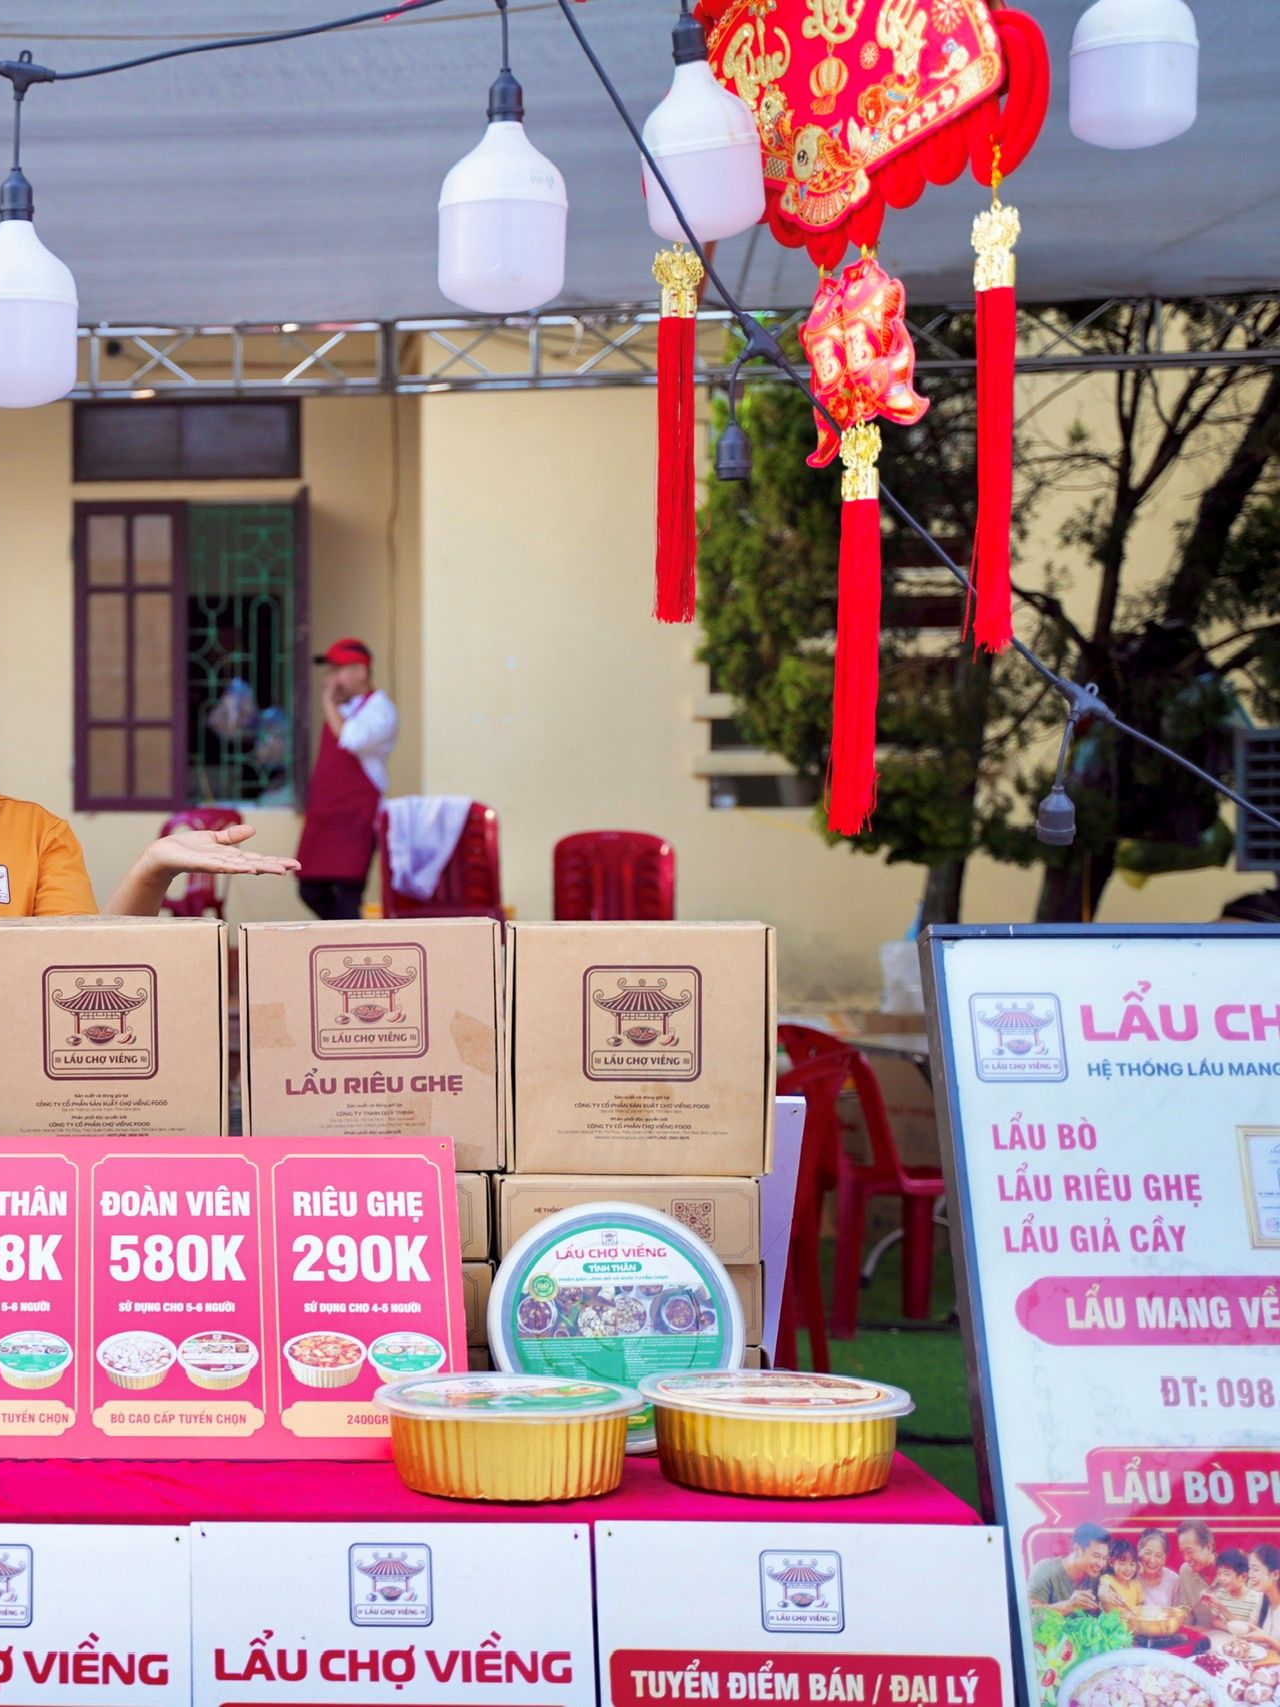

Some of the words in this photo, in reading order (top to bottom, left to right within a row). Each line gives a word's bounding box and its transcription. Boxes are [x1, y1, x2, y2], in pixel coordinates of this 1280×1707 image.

[1080, 980, 1198, 1041] LẨU
[285, 1068, 337, 1096] LẨU
[344, 1071, 403, 1095] RIÊU
[410, 1075, 463, 1096] GHẸ
[1087, 1059, 1112, 1081] HỆ
[1116, 1059, 1183, 1077] THỐNG
[1187, 1058, 1224, 1077] LẨU
[992, 1112, 1046, 1151] LẨU
[1057, 1117, 1097, 1151] BÒ
[100, 1185, 178, 1218] ĐOÀN
[185, 1185, 250, 1218] VIÊN
[997, 1162, 1052, 1202] LẨU
[1064, 1168, 1132, 1202] RIÊU
[1143, 1173, 1203, 1208] GHẸ
[293, 1186, 358, 1218] RIÊU
[367, 1191, 424, 1223] GHẸ
[1003, 1213, 1059, 1253] LẨU
[1070, 1217, 1121, 1253] GIẢ
[1130, 1215, 1186, 1253] CẦY
[109, 1234, 246, 1282] 580K
[292, 1235, 431, 1282] 290K
[589, 1247, 618, 1260] CHỢ
[1, 1301, 18, 1312] 5-6
[163, 1302, 184, 1313] CHO
[186, 1302, 203, 1313] 5-6
[349, 1303, 369, 1314] CHO
[372, 1303, 389, 1314] 4-5
[1065, 1283, 1126, 1330] LẨU
[1136, 1296, 1232, 1330] MANG
[1239, 1285, 1280, 1330] VỀ
[1160, 1376, 1208, 1407] ĐT:
[39, 1412, 69, 1425] CHỌN
[129, 1413, 151, 1424] CAO
[216, 1413, 247, 1426] CHỌN
[347, 1414, 390, 1426] 2400GR
[1102, 1456, 1171, 1504] LẨU
[1183, 1462, 1235, 1504] BÒ
[23, 1632, 169, 1685] VIỀNG
[214, 1630, 308, 1681] LẨU
[319, 1645, 416, 1689] CHỢ
[425, 1631, 573, 1684] VIỀNG
[630, 1659, 719, 1699] TUYỂN
[727, 1660, 799, 1700] ĐIỂM
[809, 1667, 864, 1702] BÁN
[872, 1674, 883, 1704] /
[889, 1673, 937, 1707] ĐẠI
[946, 1668, 980, 1704] LÝ
